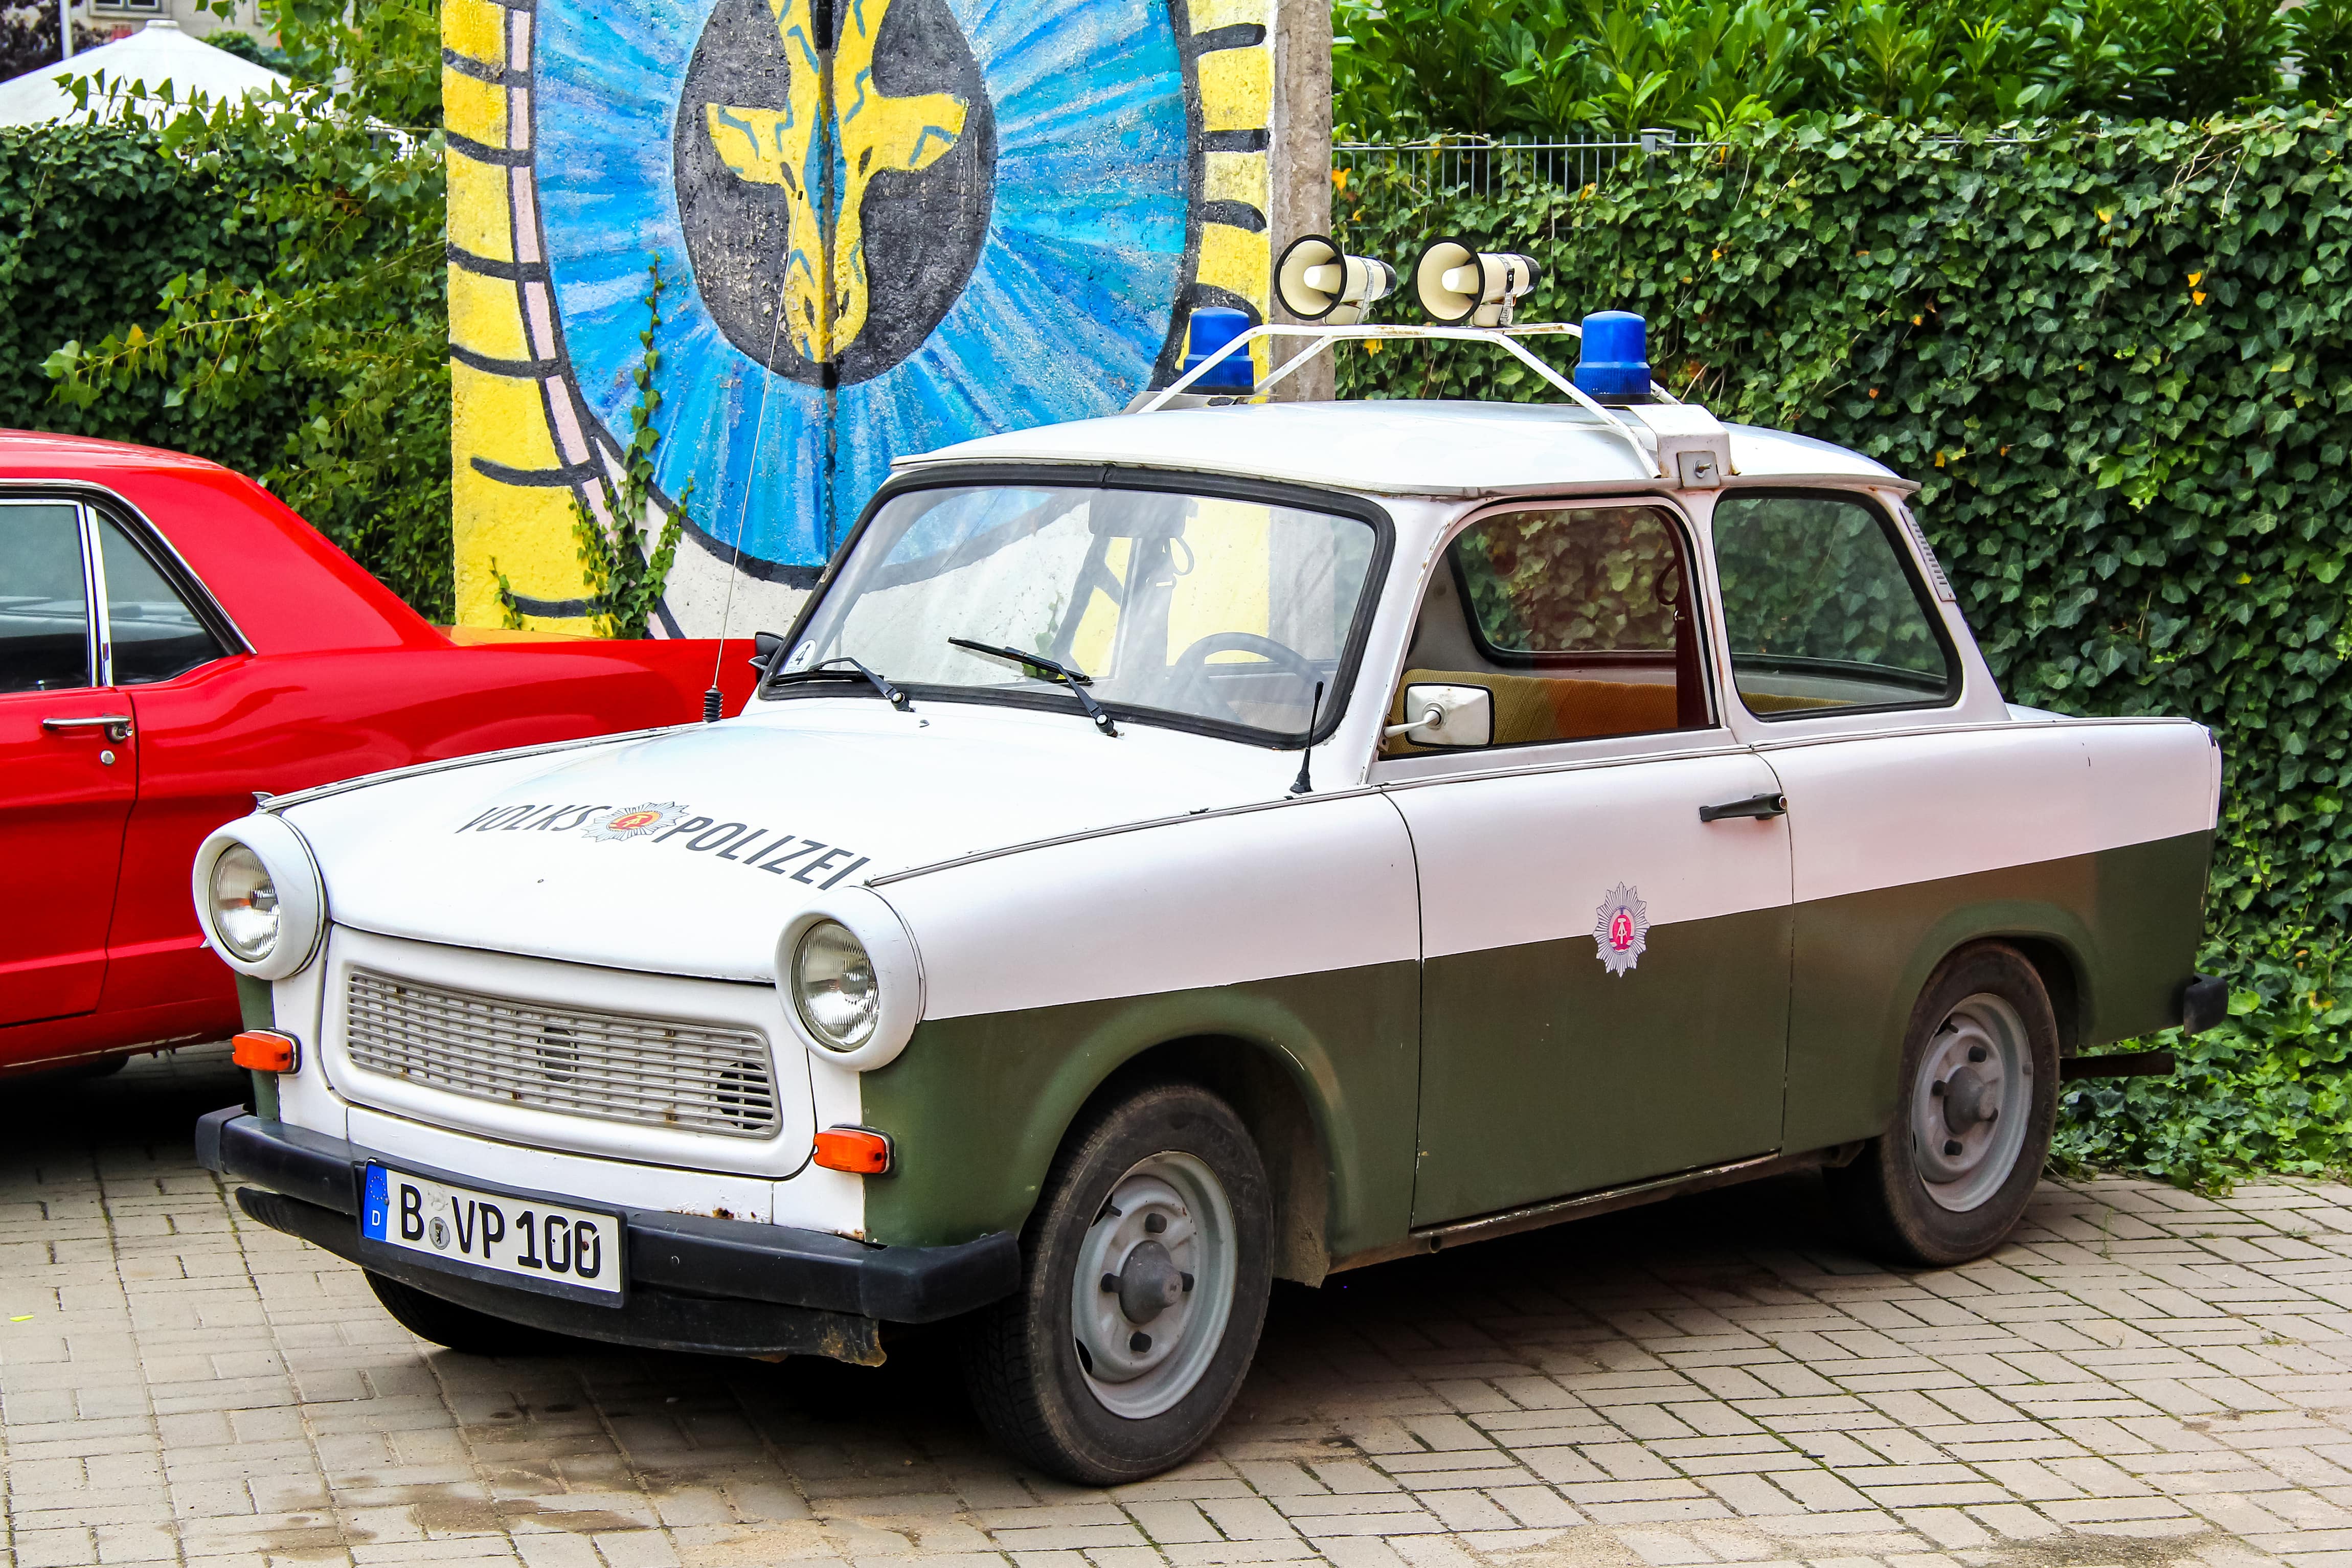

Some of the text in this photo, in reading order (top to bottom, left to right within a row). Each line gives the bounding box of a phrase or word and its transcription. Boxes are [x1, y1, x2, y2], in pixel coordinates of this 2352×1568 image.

[454, 805, 871, 891] VOLKS POLIZEI
[371, 1210, 380, 1226] D
[400, 1183, 424, 1241] B
[451, 1196, 506, 1259] VP
[516, 1211, 601, 1279] 100
